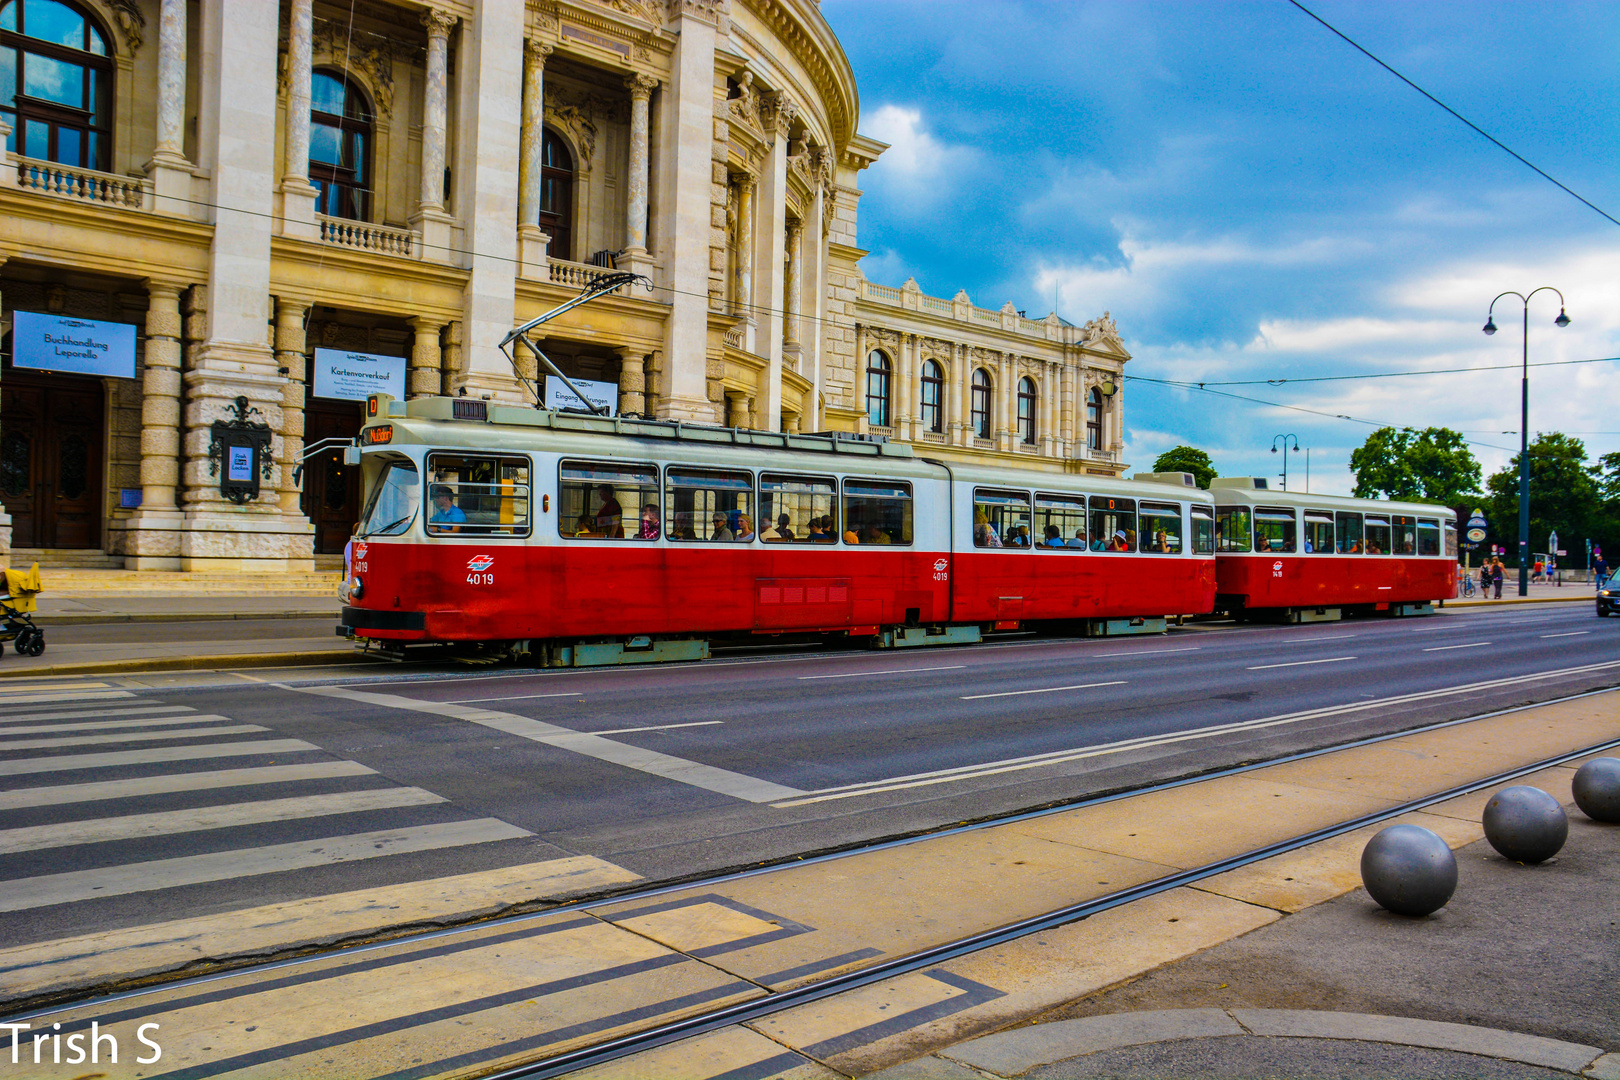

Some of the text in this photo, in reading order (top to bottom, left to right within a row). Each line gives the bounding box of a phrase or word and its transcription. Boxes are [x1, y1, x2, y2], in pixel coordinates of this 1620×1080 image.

[44, 333, 108, 351] Buchhandlung
[55, 346, 98, 359] Leporello
[331, 366, 390, 380] Kartenvorverkauf
[555, 391, 578, 403] Eingang
[370, 399, 377, 413] D
[370, 427, 392, 442] Nußdorf
[355, 561, 368, 572] 4019
[466, 573, 494, 585] 4019
[933, 572, 948, 581] 4019
